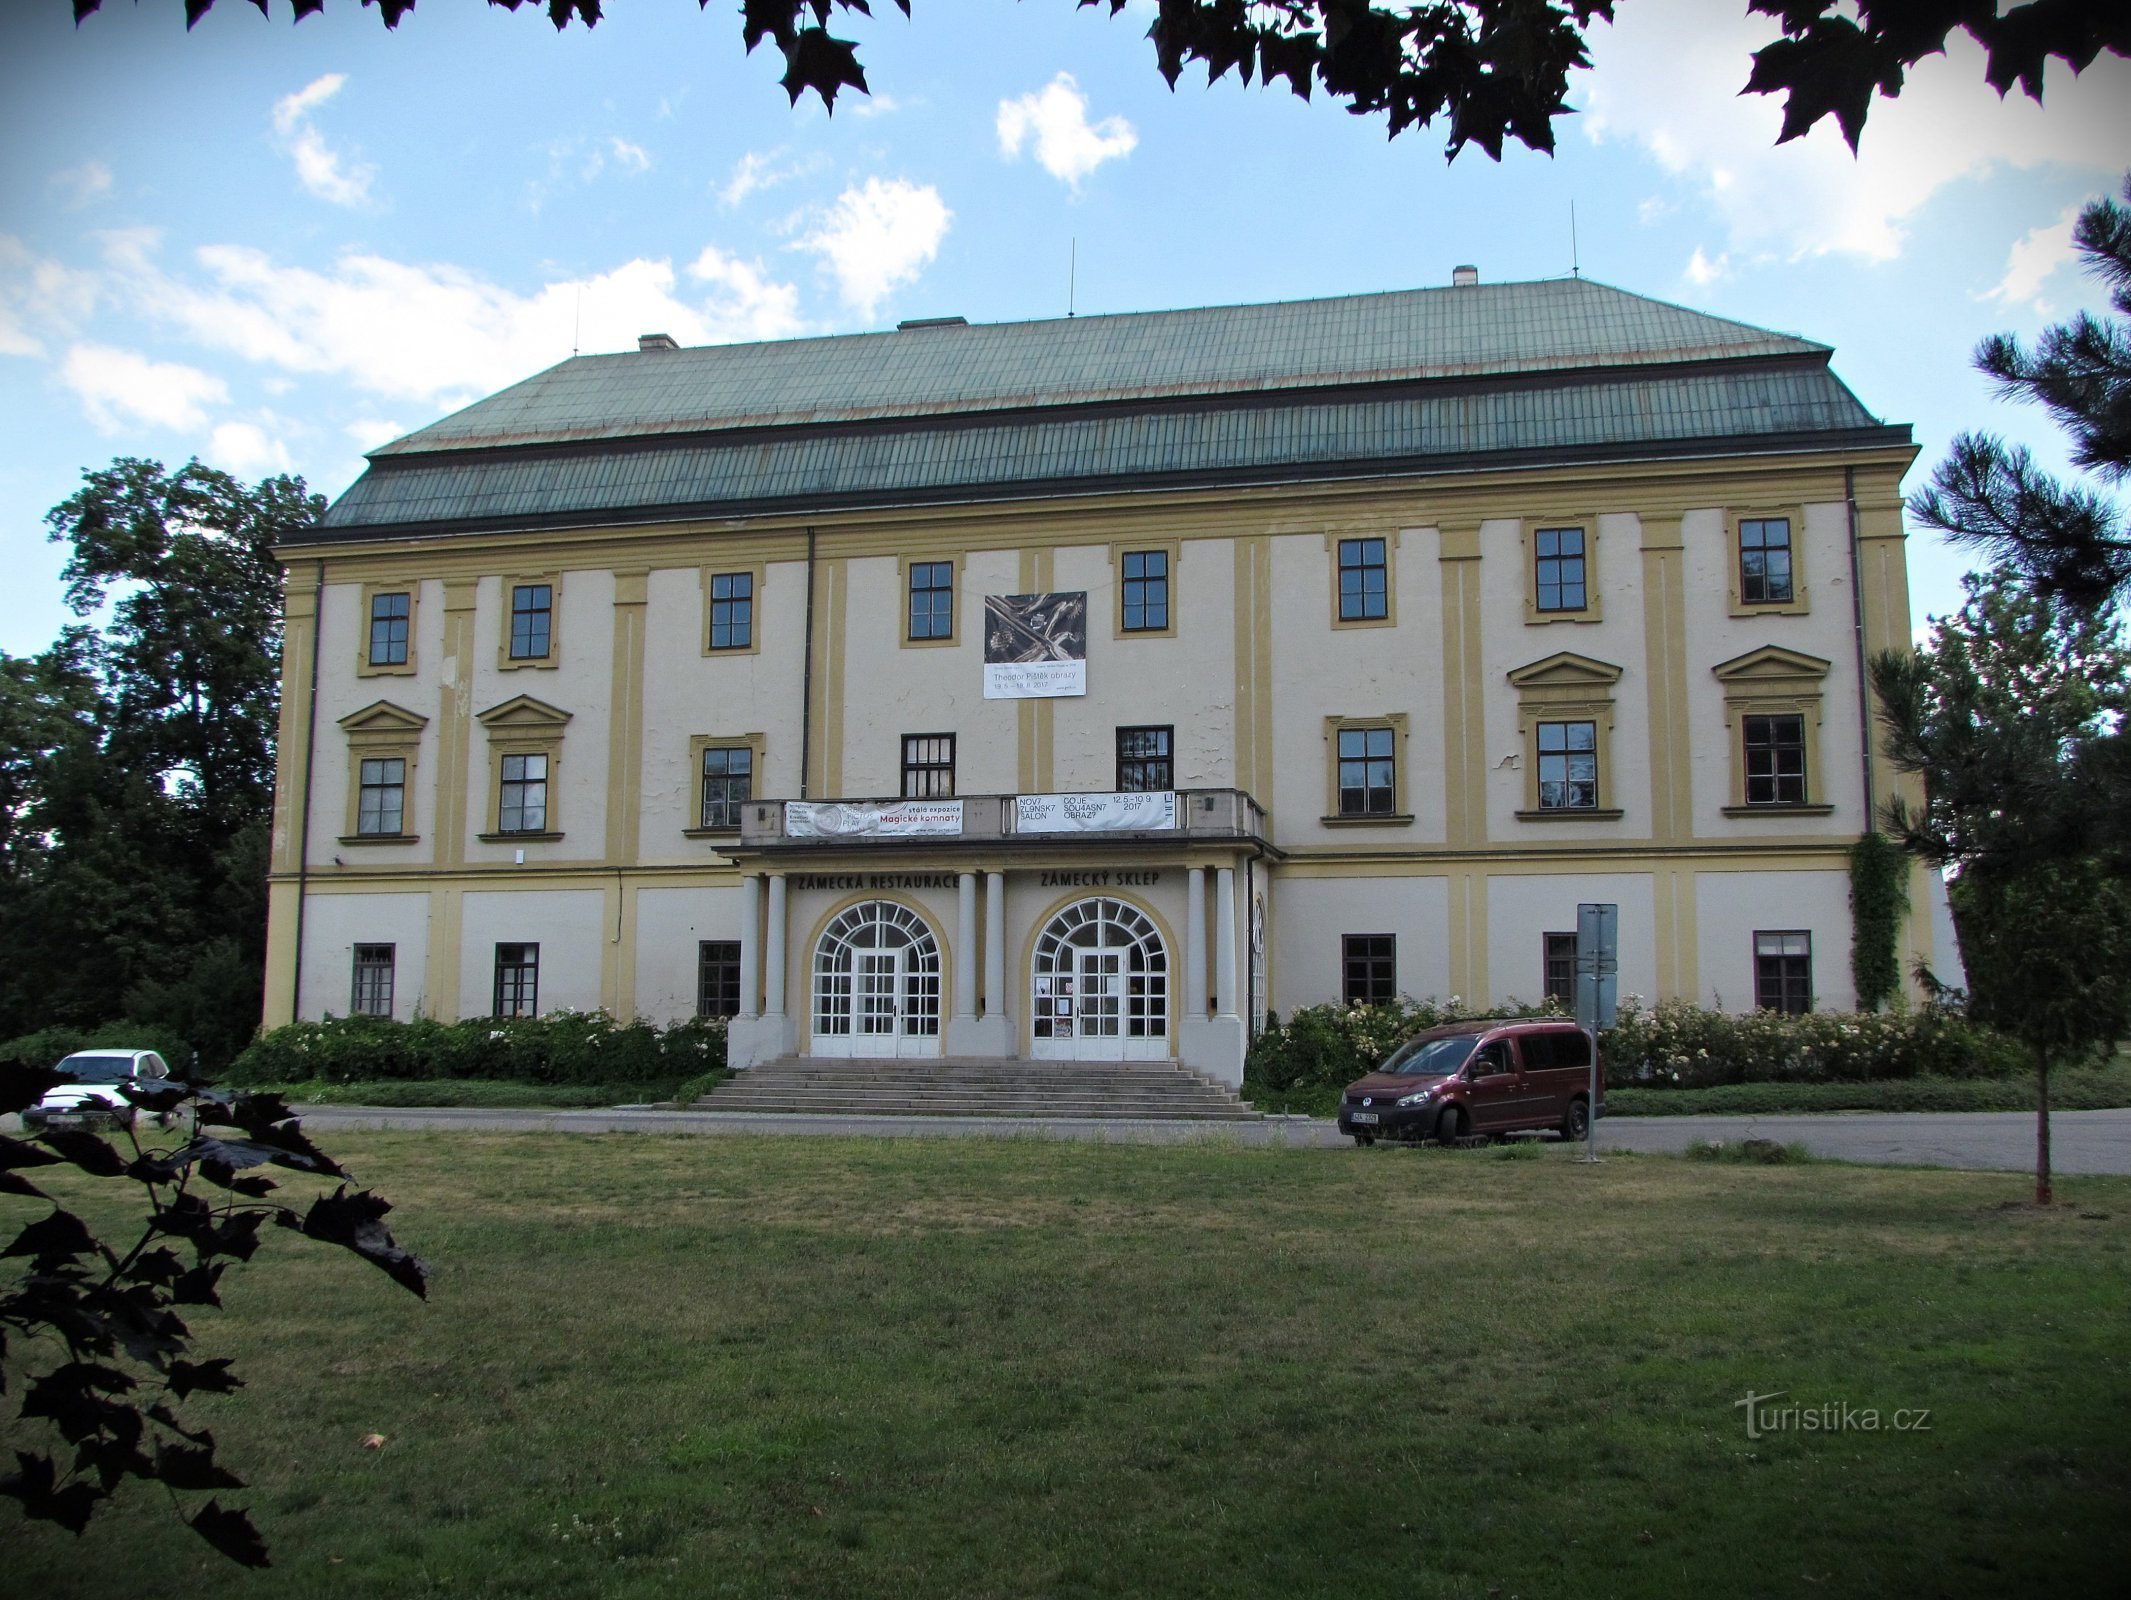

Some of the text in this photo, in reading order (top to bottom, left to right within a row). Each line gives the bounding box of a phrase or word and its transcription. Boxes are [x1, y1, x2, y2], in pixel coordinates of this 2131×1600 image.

[994, 673, 1024, 681] Theodor
[1050, 671, 1077, 680] obrazy
[929, 806, 961, 814] expozice
[1123, 803, 1142, 811] 2017
[1021, 812, 1047, 820] SALON
[1063, 811, 1096, 819] OBRAZ?
[880, 815, 960, 825] Magické komnaty
[798, 874, 960, 890] ZÁMECKÁ RESTAURACE
[1041, 870, 1159, 887] ZÁMECKÝ SKLEP
